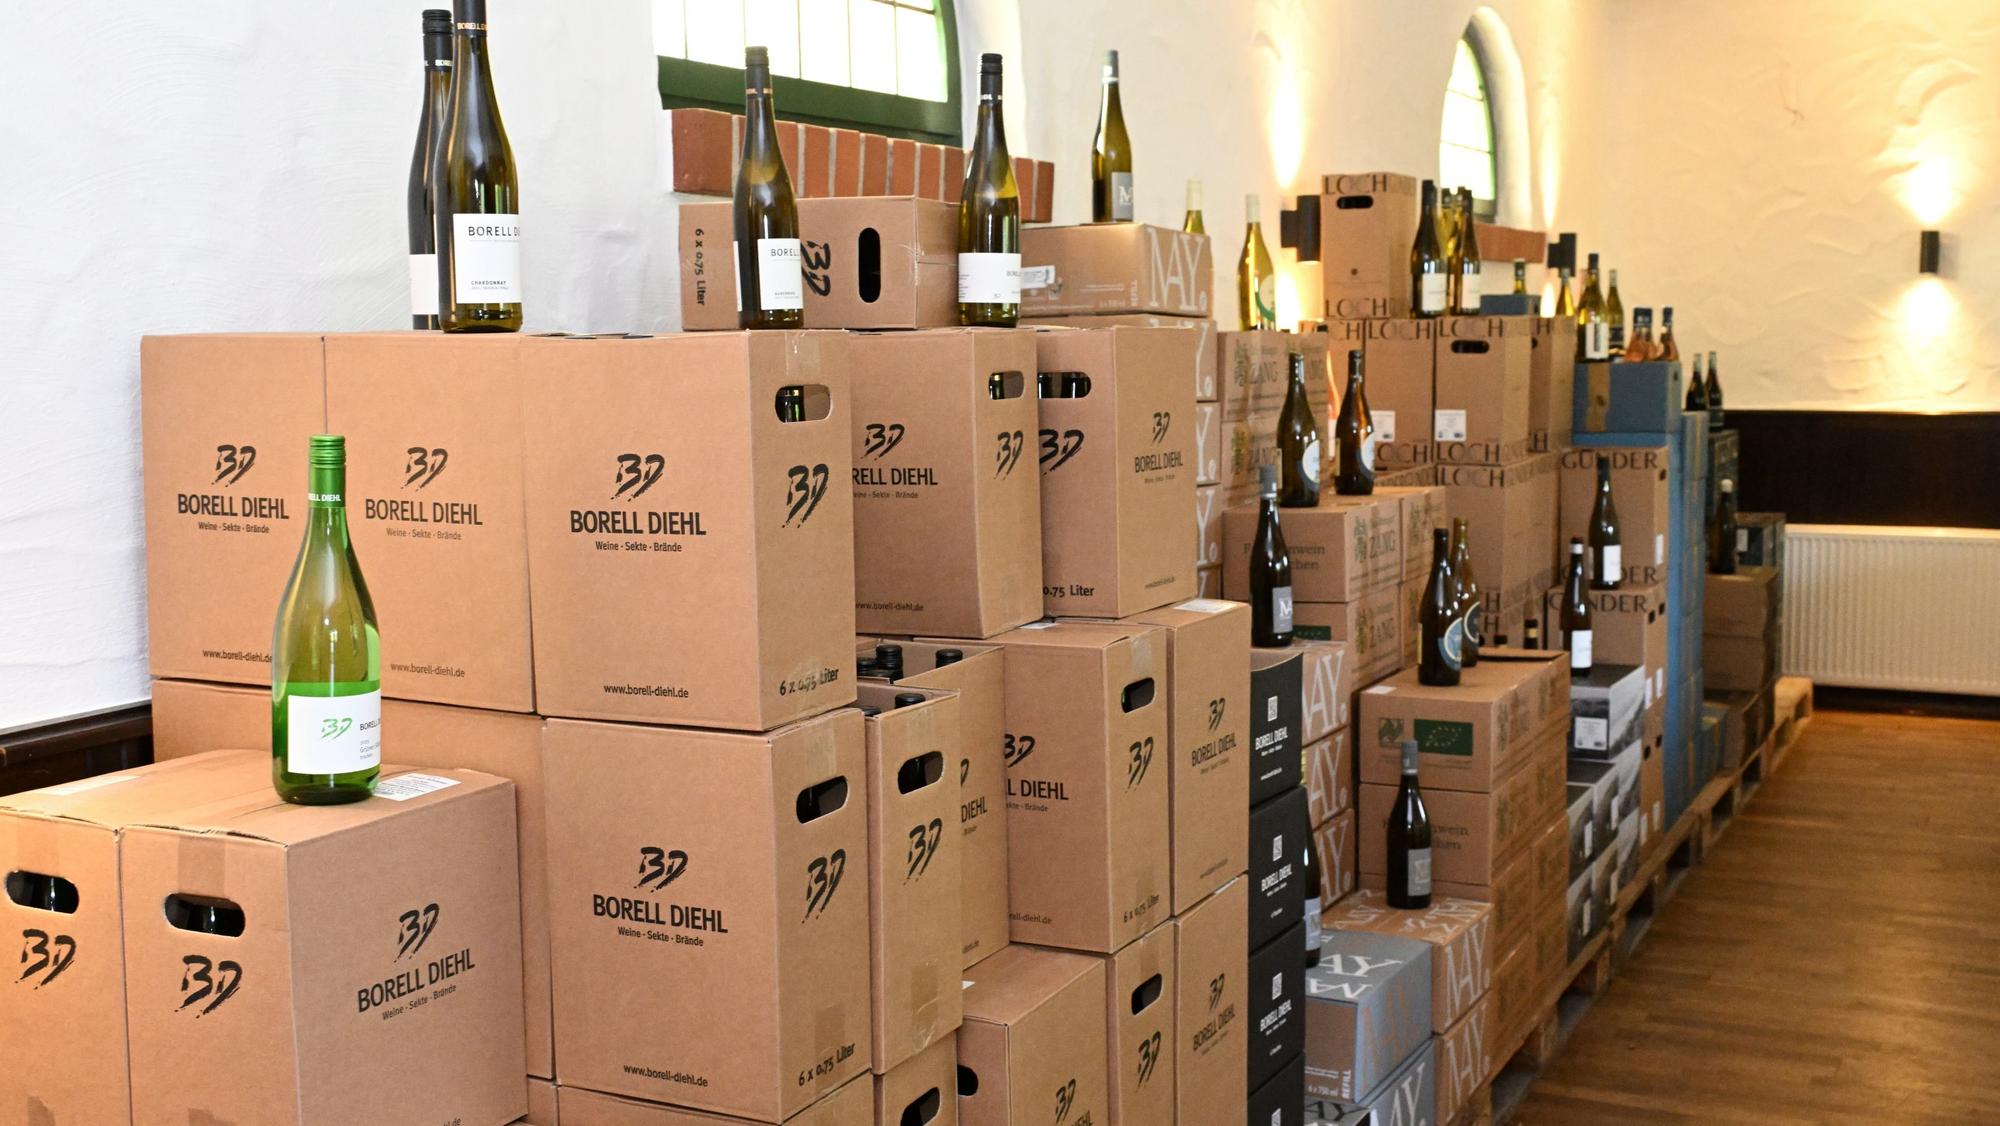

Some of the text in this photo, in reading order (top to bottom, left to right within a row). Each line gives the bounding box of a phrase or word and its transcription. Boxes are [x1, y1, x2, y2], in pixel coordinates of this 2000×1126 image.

[468, 226, 511, 236] BORELL
[695, 228, 705, 236] 6
[696, 281, 707, 306] Liter
[1135, 451, 1183, 473] BORELL DIEHL
[852, 467, 938, 486] RELL DIEHL
[177, 493, 289, 520] BORELL DIEHL
[365, 498, 483, 525] BORELL DIEHL
[198, 521, 269, 534] Weine Sekte Brände
[386, 528, 461, 540] Weine Sekte Brände
[570, 510, 706, 535] BORELL DIEHL
[595, 541, 682, 552] Weine Sekte Brände
[1070, 585, 1095, 597] Liter
[390, 663, 465, 678] www.borell-diehl.de
[603, 683, 689, 698] www.borell-diehl.de
[779, 681, 787, 697] 6
[819, 668, 839, 684] Liter
[1191, 743, 1217, 767] BORELL
[1020, 779, 1069, 801] DIEHL
[961, 796, 988, 823] DIEHL
[593, 894, 728, 934] BORELL DIEHL
[618, 926, 704, 947] Weine Sekte Brände
[358, 948, 476, 1014] BORELL DIEHL
[383, 984, 457, 1021] Weine Sekte Brände
[623, 1063, 709, 1087] www.borell-diehl.de
[799, 1071, 806, 1087] 6
[808, 1068, 814, 1082] x
[836, 1043, 856, 1064] Liter
